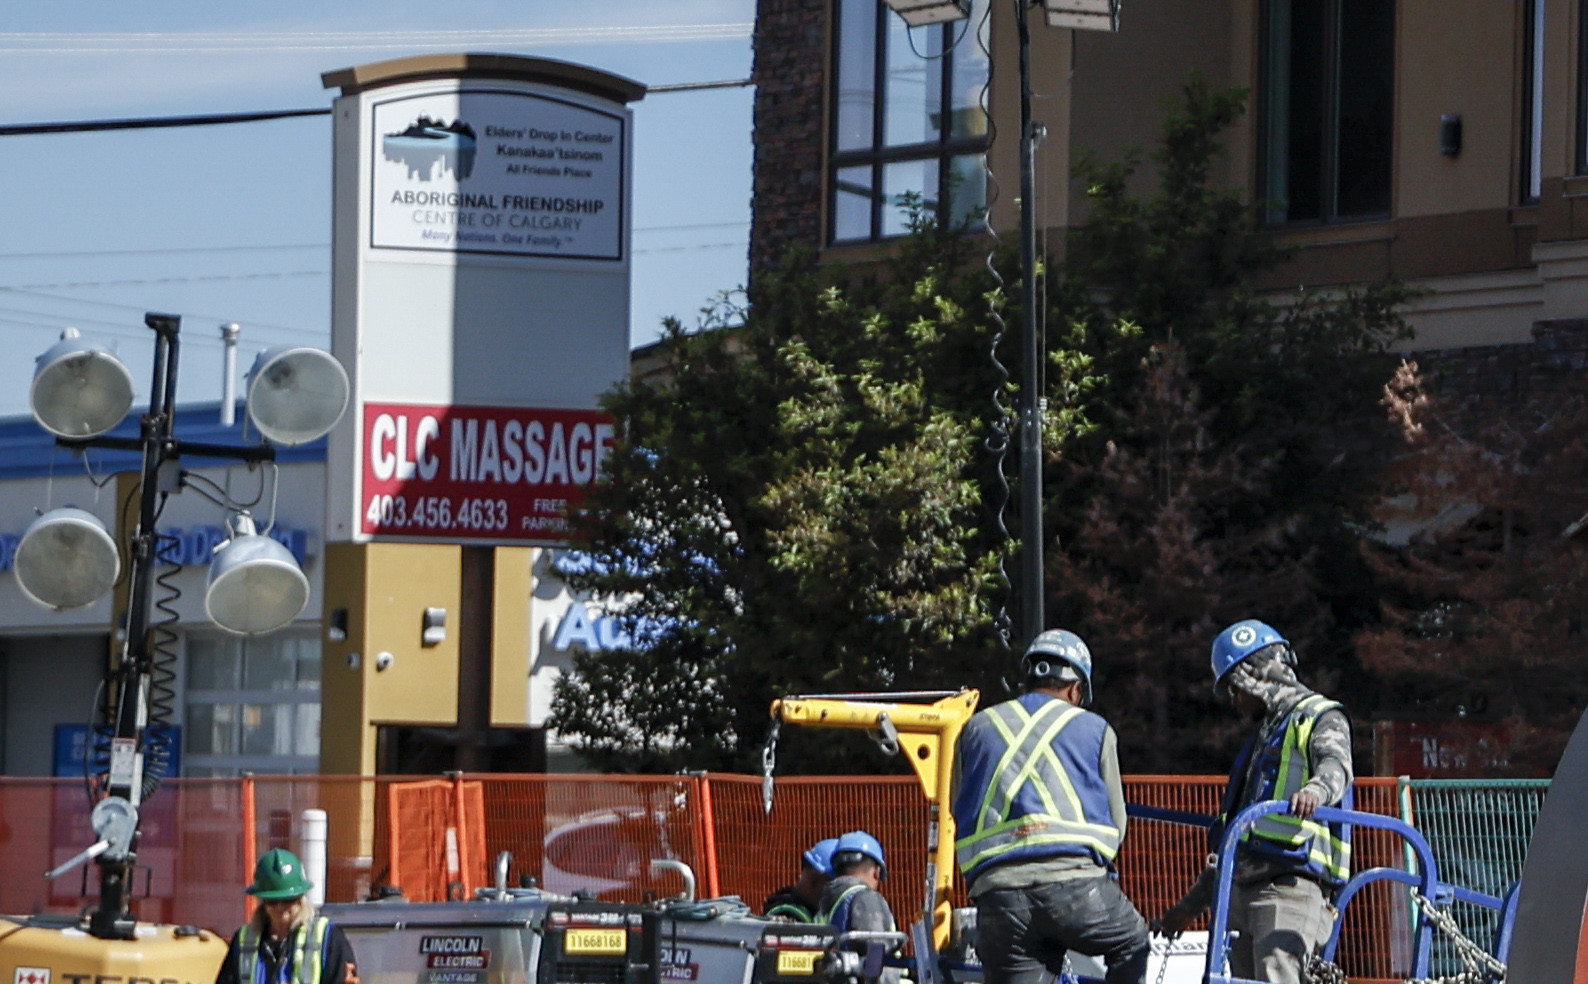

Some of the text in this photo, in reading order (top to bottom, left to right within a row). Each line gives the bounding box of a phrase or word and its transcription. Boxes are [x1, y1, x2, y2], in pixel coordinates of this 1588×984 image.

[529, 127, 557, 142] Drop
[561, 129, 571, 141] In
[574, 130, 613, 144] Center
[507, 163, 592, 178] All Friends Place
[391, 190, 604, 214] ABORIGINAL FRIENDSHIP
[412, 209, 583, 231] CENTRE OF CALGARY
[422, 228, 452, 244] Many
[503, 232, 522, 244] One
[370, 413, 614, 485] CLC MASSAGE
[366, 494, 508, 531] 403.456.4633
[522, 516, 571, 531] PARKIN
[422, 937, 480, 952] LINCOLN
[570, 935, 622, 948] 11668168
[433, 954, 484, 967] ELECTRIC
[782, 956, 813, 968] 116681
[429, 973, 477, 983] VANTAGE
